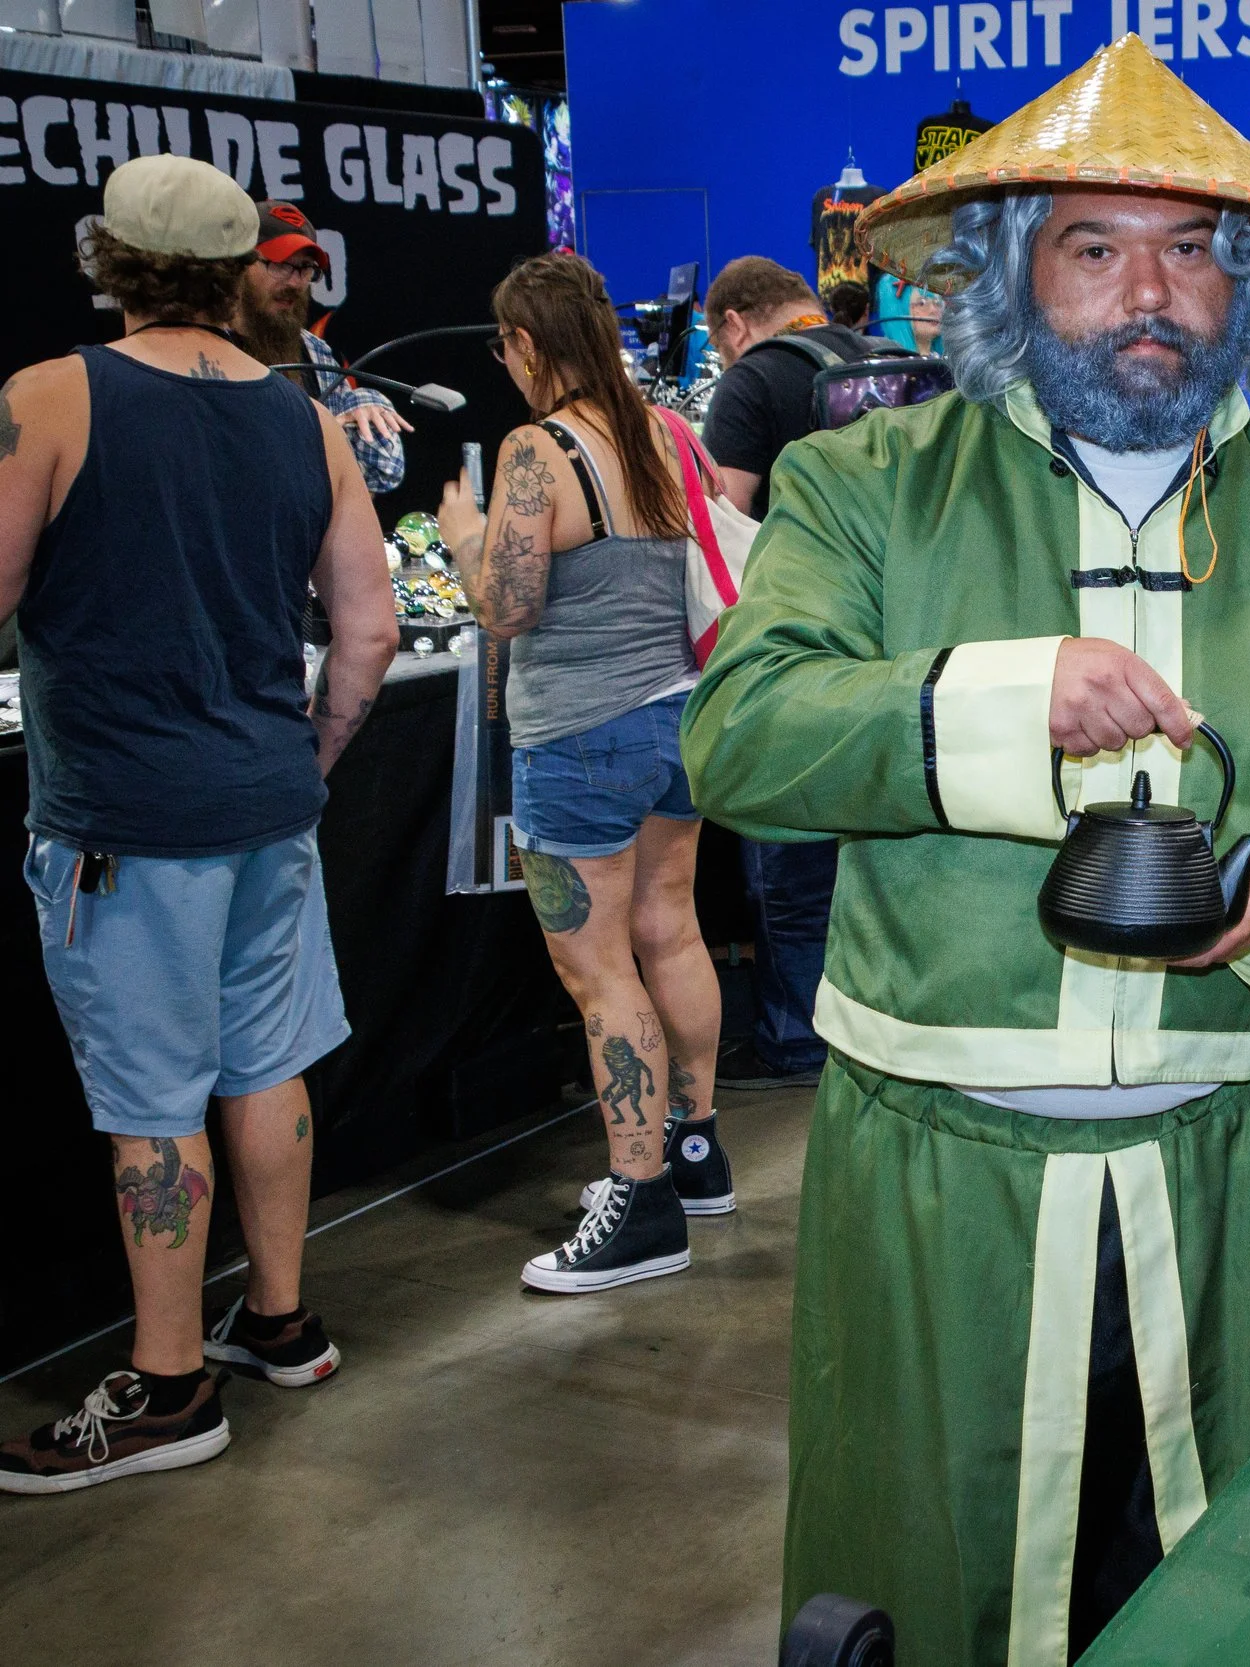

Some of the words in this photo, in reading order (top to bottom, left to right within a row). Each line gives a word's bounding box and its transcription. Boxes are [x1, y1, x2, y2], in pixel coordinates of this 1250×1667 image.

[838, 0, 1073, 77] SPIRIT
[323, 123, 517, 216] GLASS
[486, 641, 498, 686] FROM
[487, 687, 498, 720] RUN
